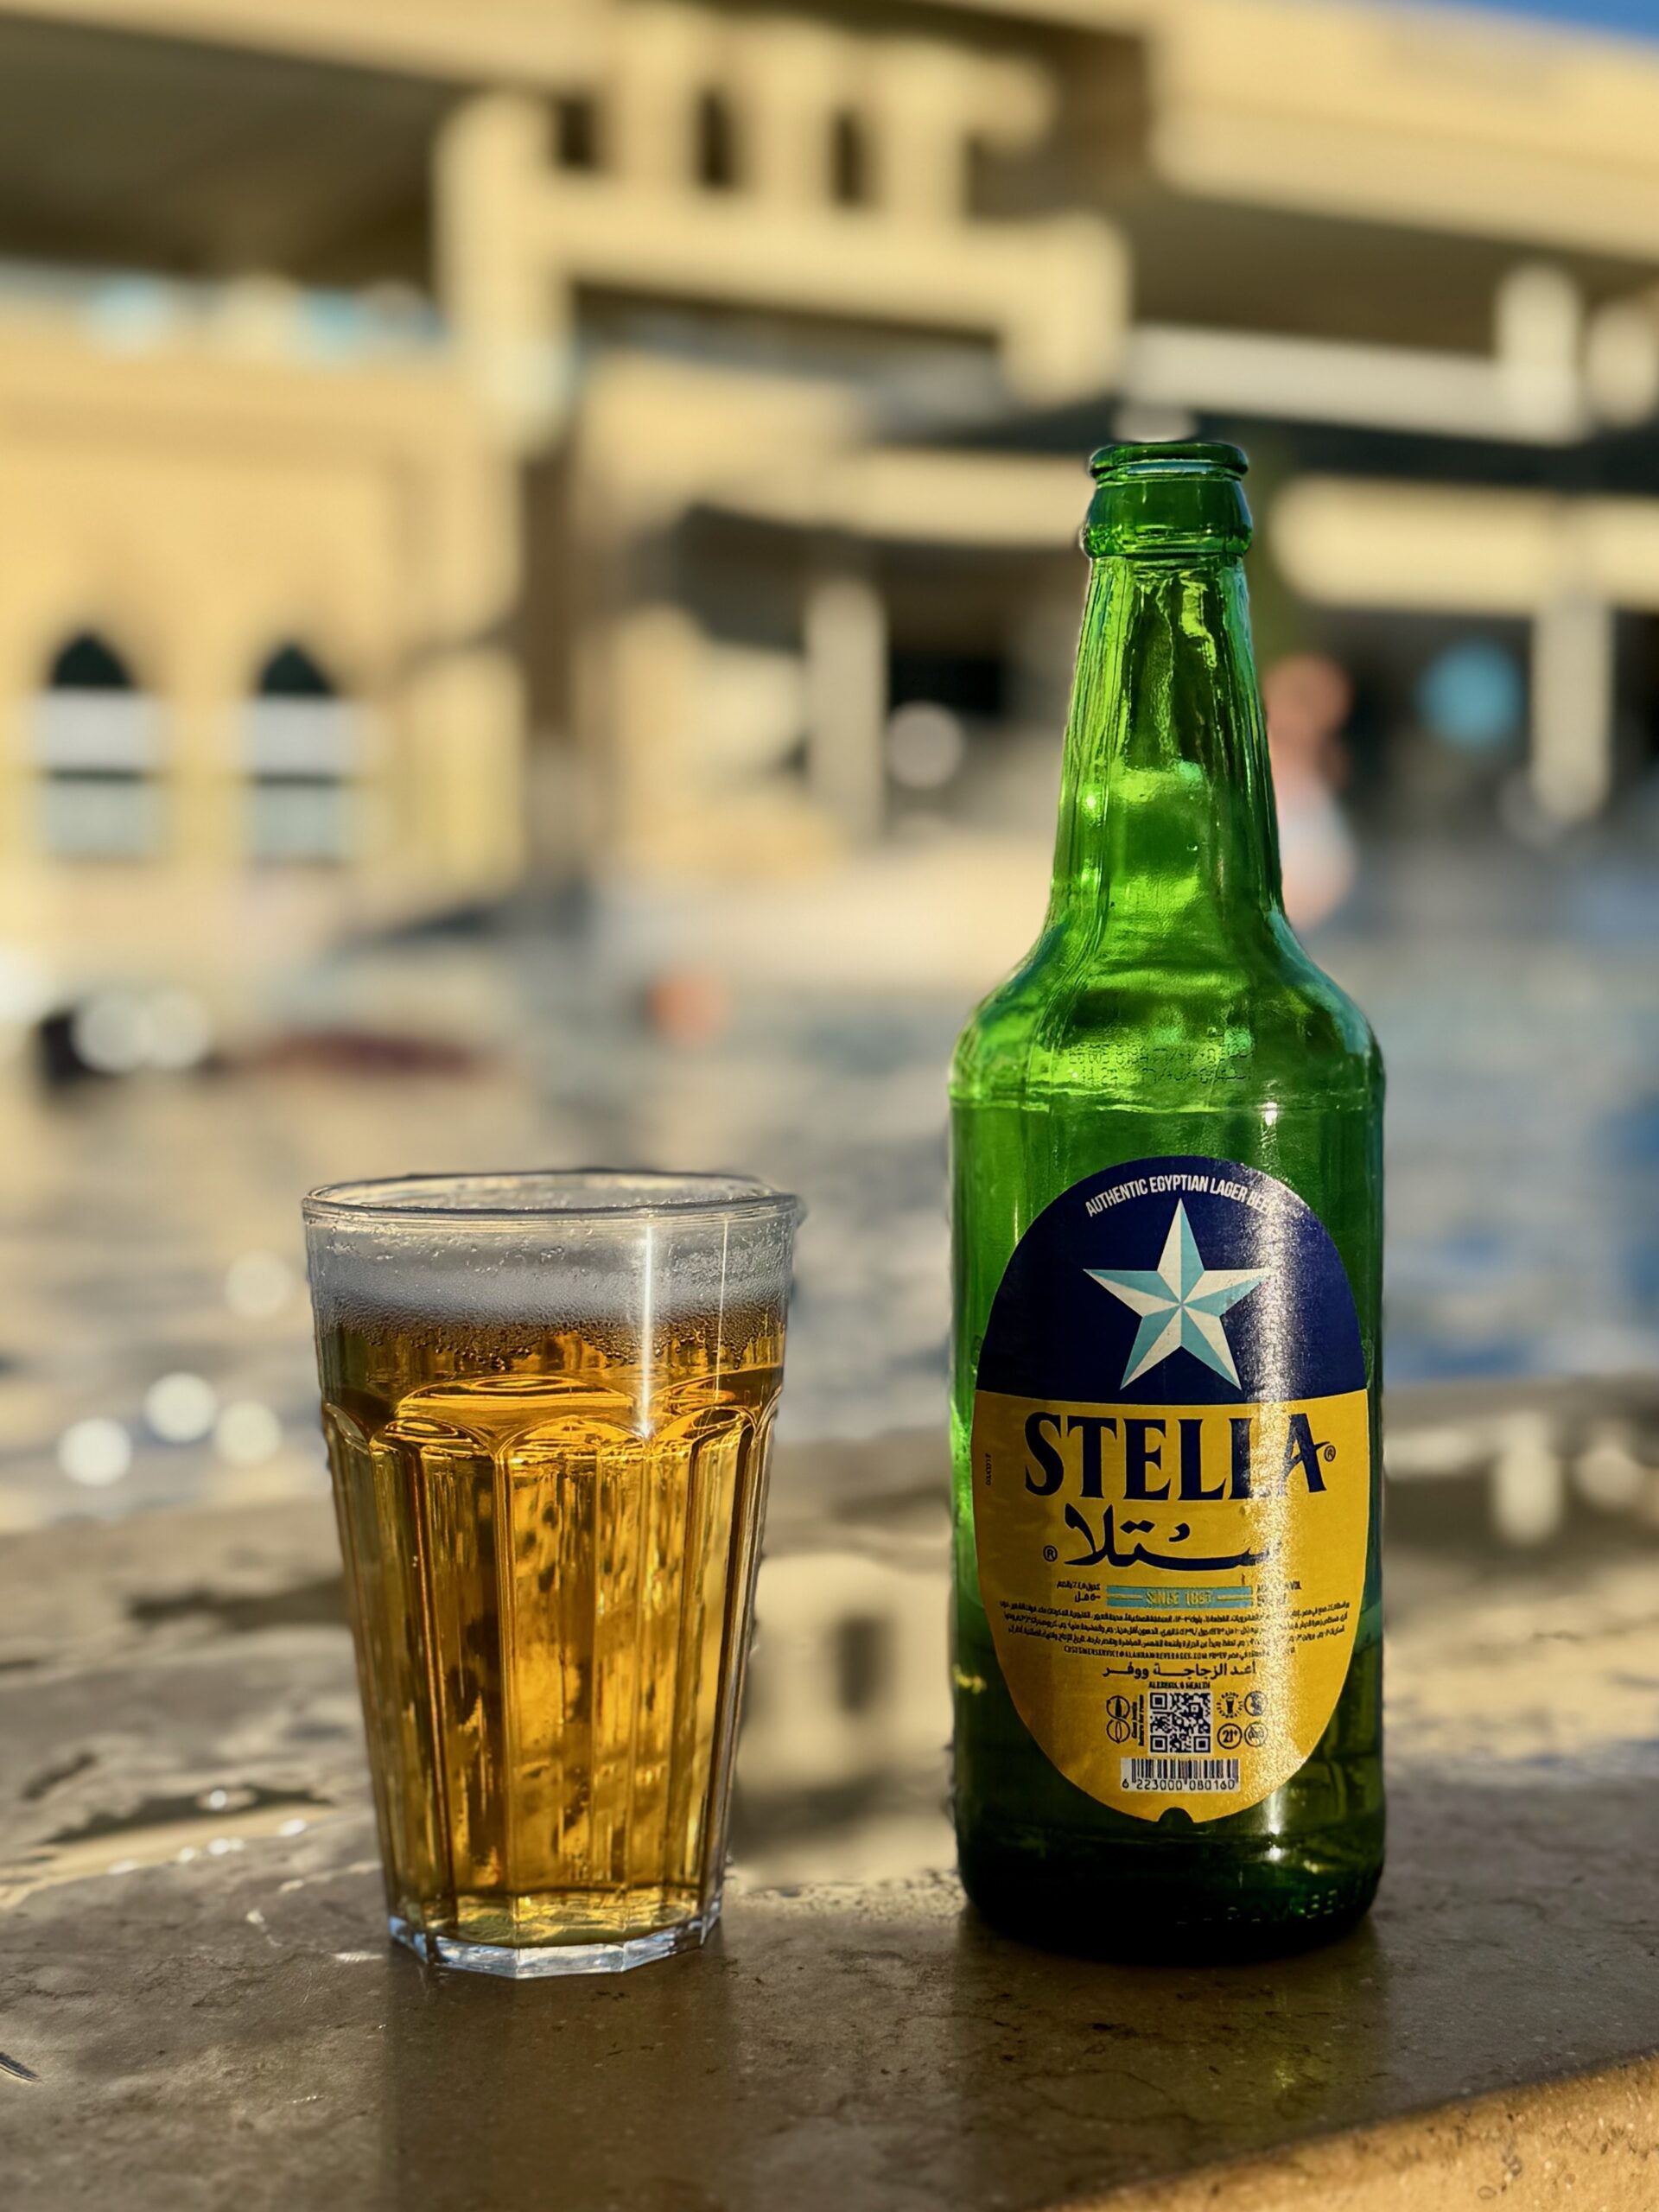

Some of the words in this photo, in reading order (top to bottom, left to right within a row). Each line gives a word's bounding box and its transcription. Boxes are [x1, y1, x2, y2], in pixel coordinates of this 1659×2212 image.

[1084, 1179, 1148, 1217] AUTHENTIC
[1148, 1173, 1209, 1193] EGYPTIAN
[1210, 1177, 1249, 1204] LAGER
[1246, 1190, 1274, 1217] BEE
[1024, 1411, 1330, 1501] STELLA
[1102, 1661, 1150, 1680] ووفر
[1153, 1662, 1228, 1681] الزجاجة
[1230, 1659, 1256, 1676] أعد
[1122, 1778, 1129, 1789] 6
[1136, 1778, 1183, 1791] 223000
[1189, 1779, 1236, 1791] 080160
